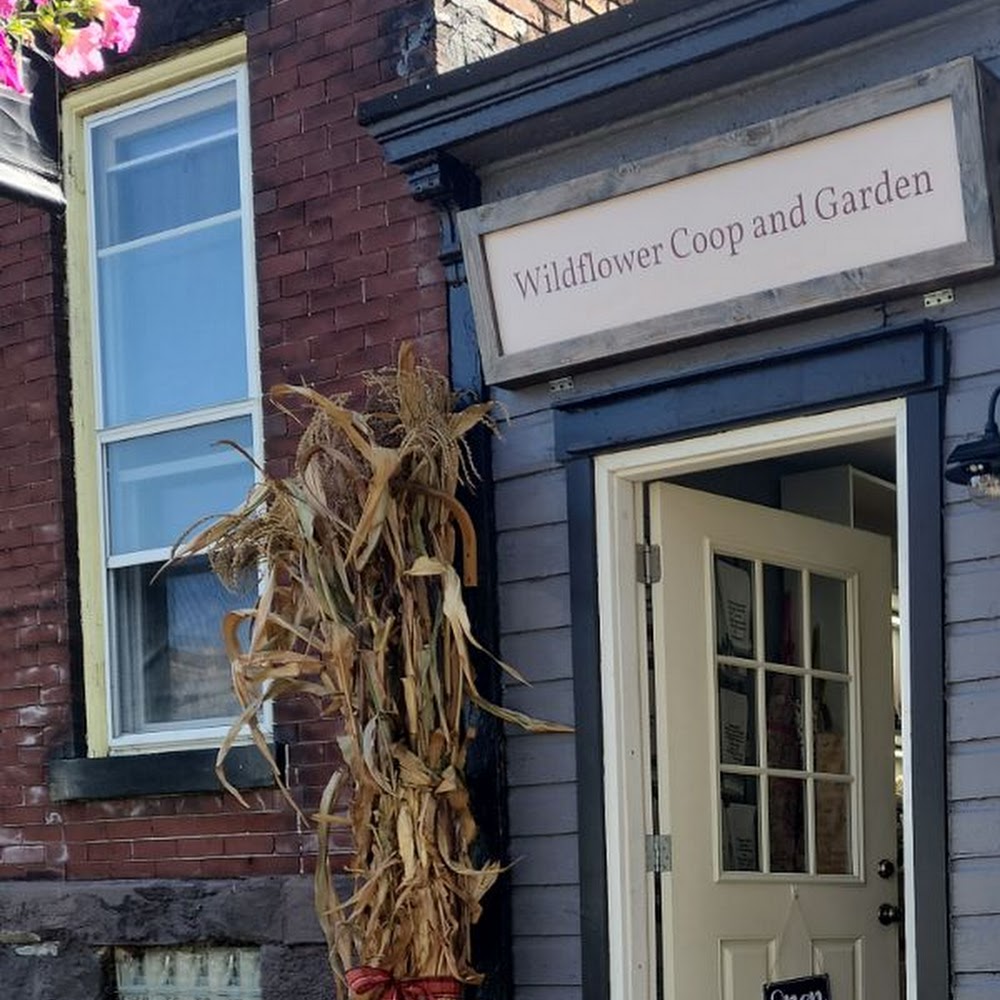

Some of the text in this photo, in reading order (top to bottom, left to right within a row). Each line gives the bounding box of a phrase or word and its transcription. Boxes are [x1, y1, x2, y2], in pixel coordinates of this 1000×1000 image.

[513, 167, 934, 300] Wildflower Coop and Garden
